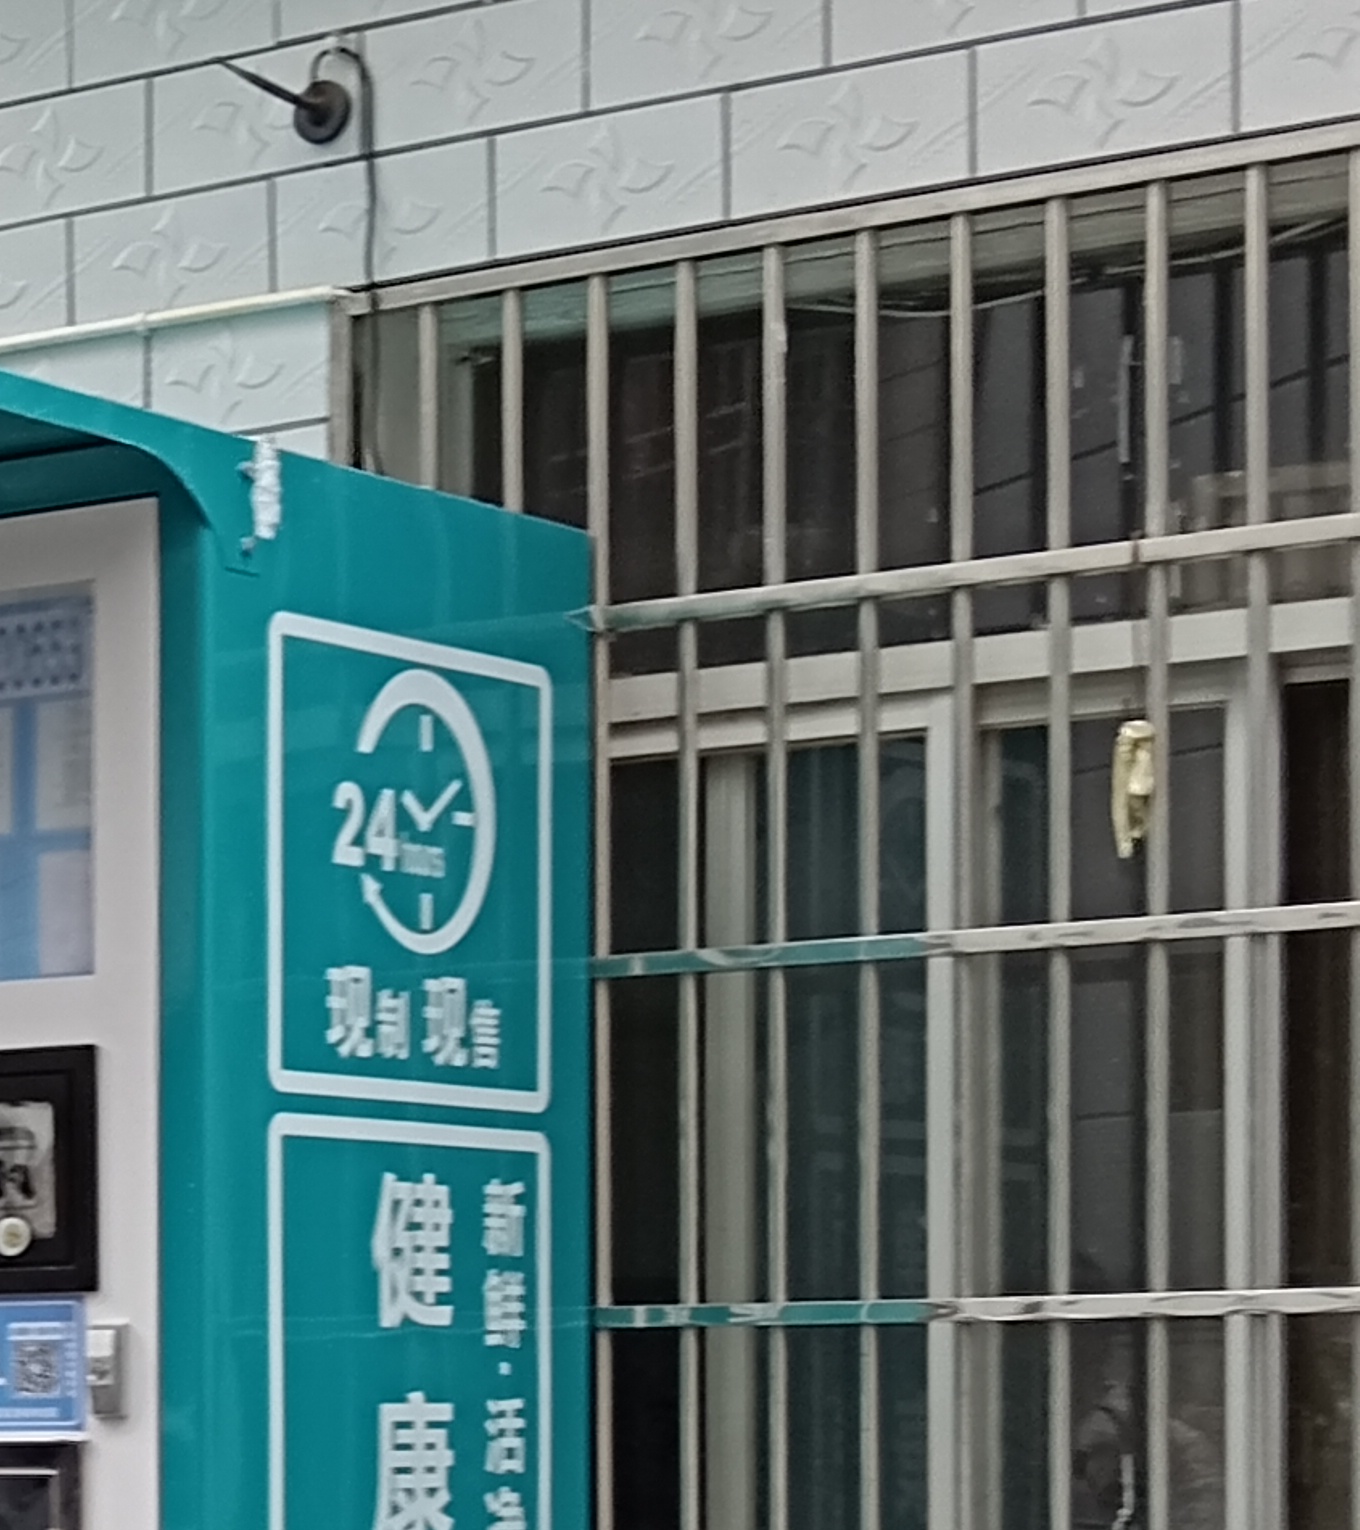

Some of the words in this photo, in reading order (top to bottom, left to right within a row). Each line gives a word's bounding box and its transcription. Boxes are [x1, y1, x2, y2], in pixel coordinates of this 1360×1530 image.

[331, 781, 399, 871] 24
[325, 965, 502, 1069] 现制现售
